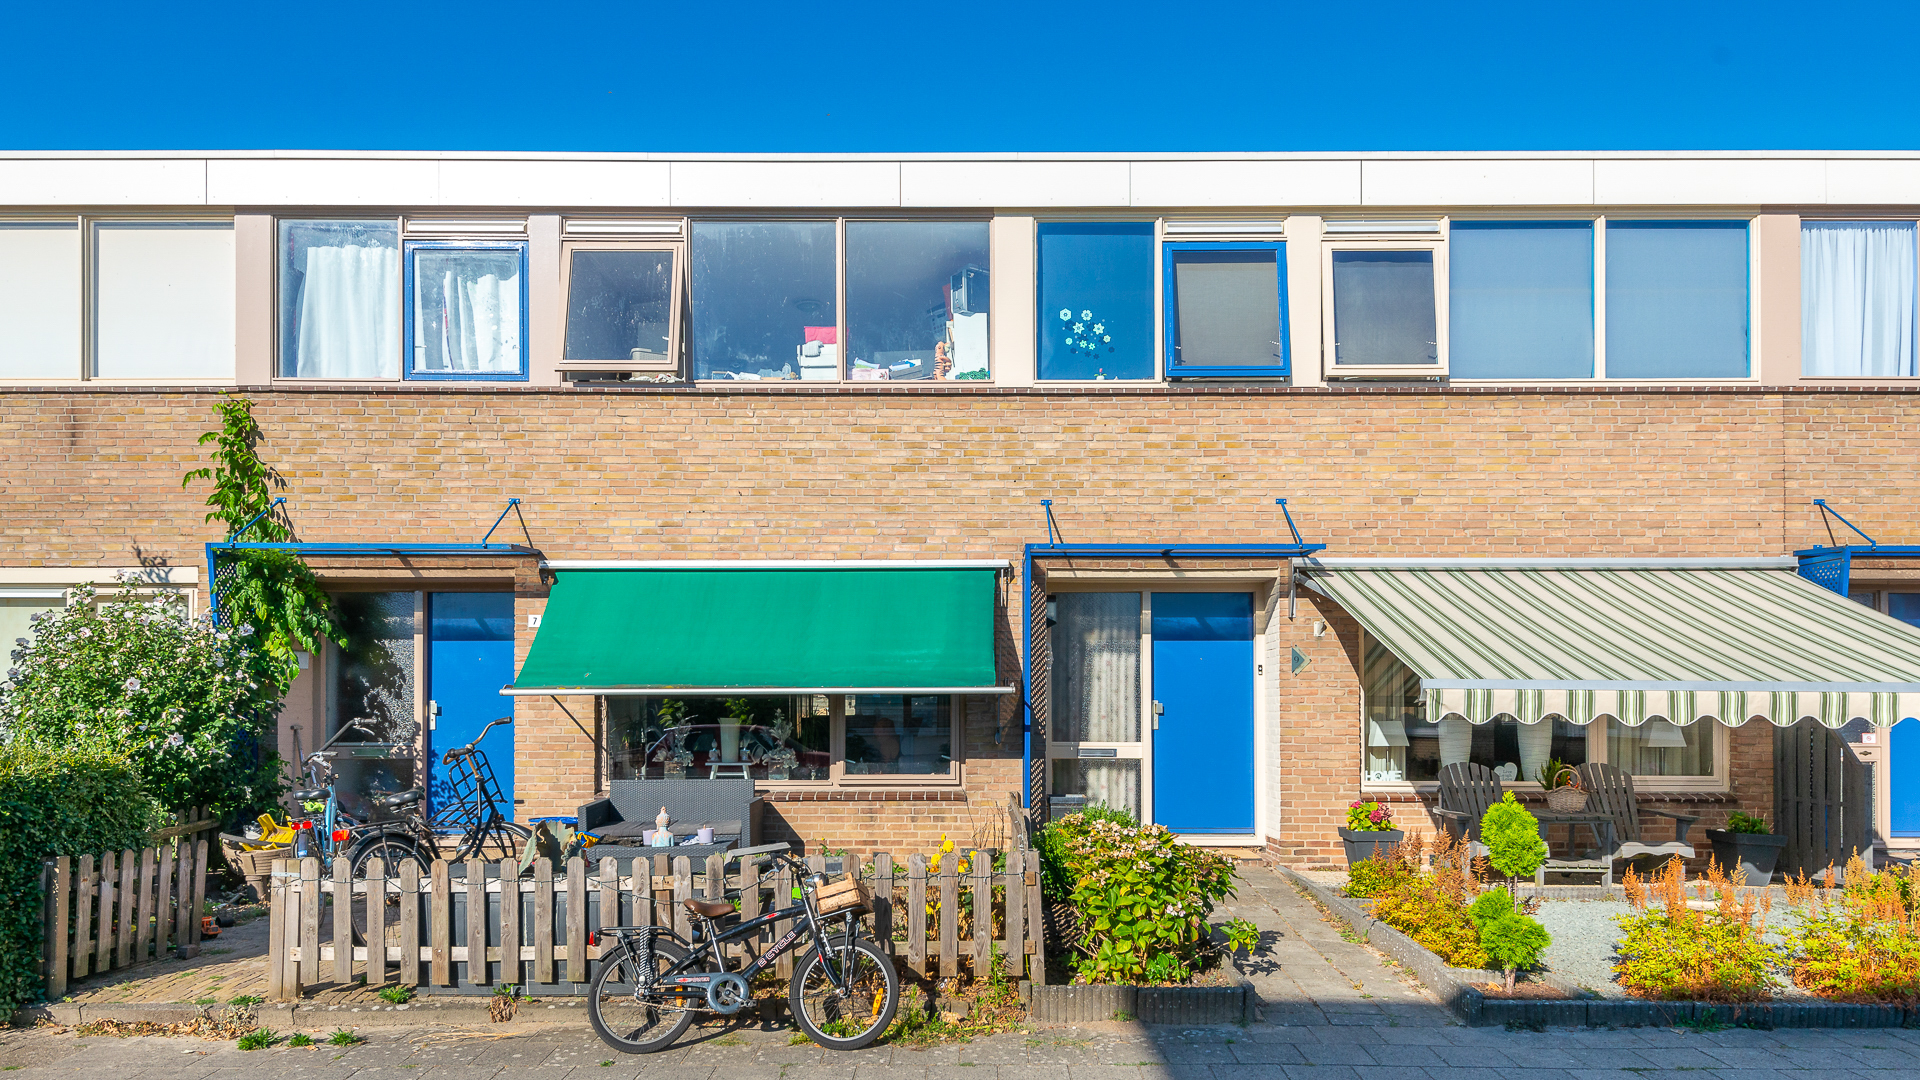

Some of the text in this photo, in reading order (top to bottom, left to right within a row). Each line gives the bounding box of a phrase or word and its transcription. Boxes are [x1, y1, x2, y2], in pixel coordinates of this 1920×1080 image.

[532, 617, 538, 625] 7
[1293, 656, 1299, 664] 9
[1365, 770, 1402, 781] HOME
[765, 930, 797, 960] CYCLE
